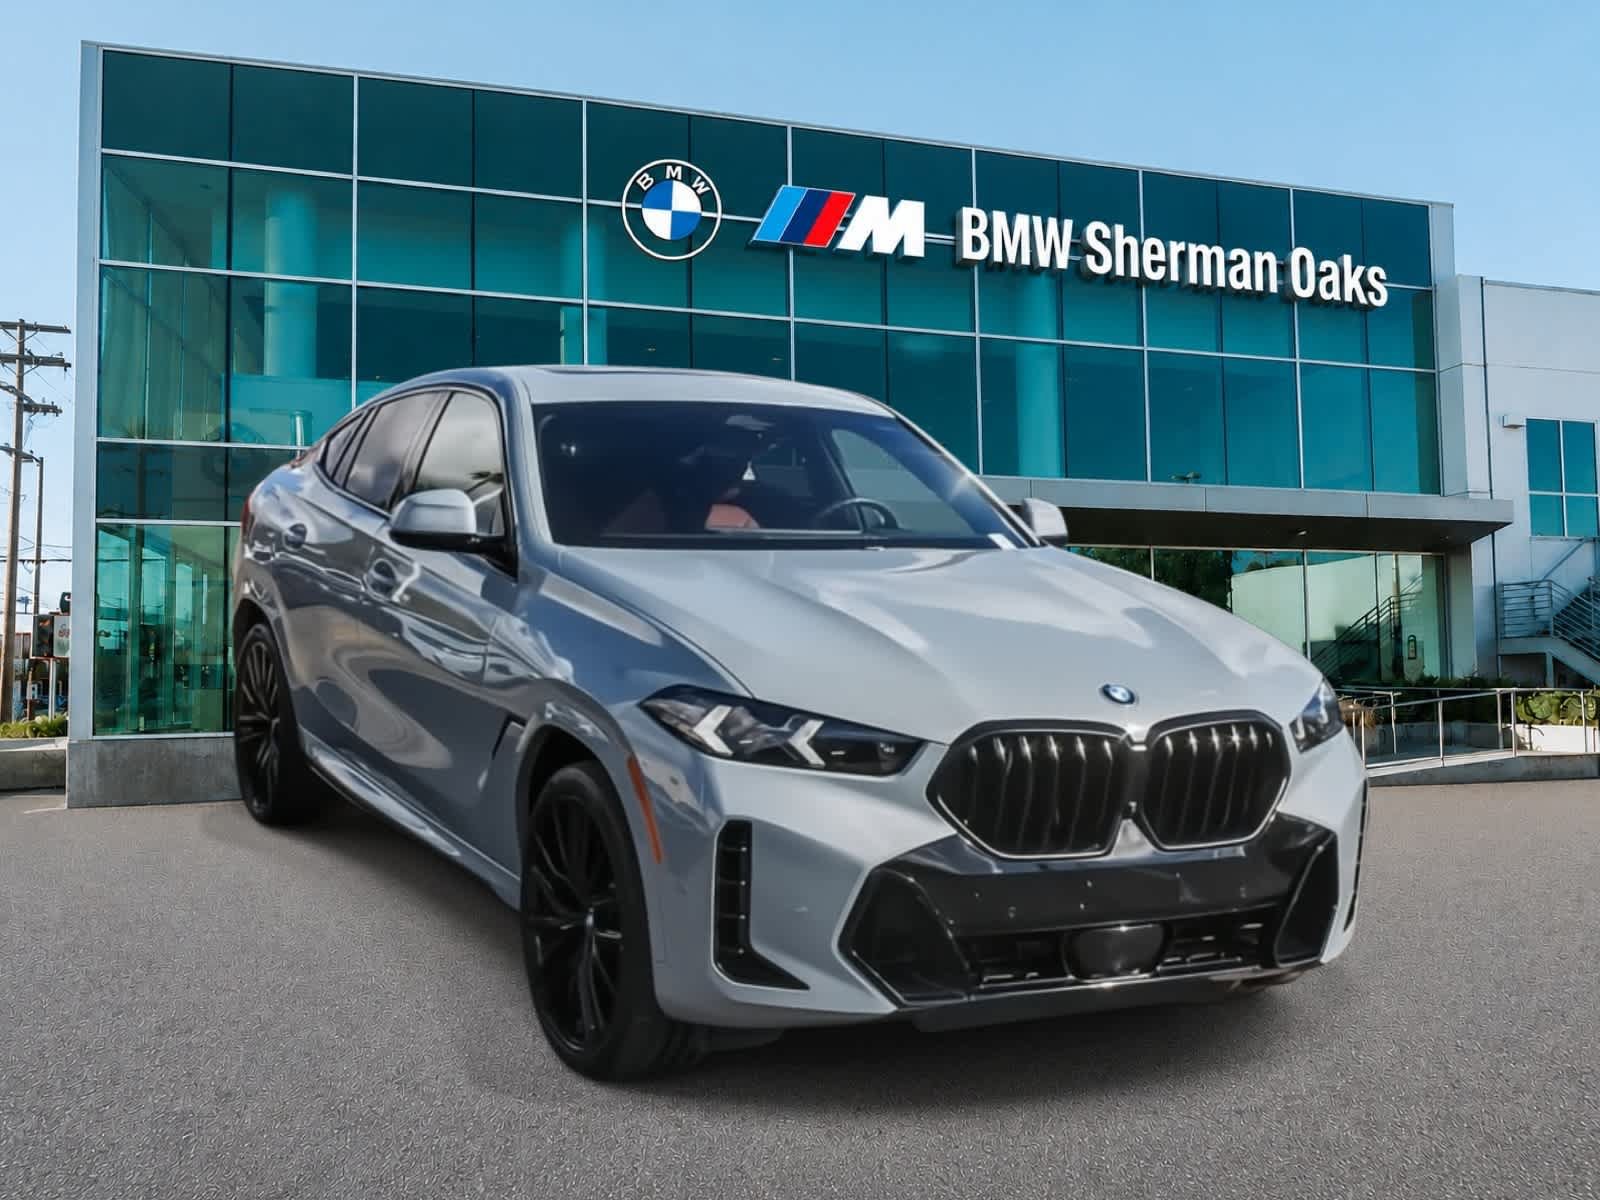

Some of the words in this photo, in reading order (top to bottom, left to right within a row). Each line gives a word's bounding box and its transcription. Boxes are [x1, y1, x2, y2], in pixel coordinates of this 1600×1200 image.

[636, 165, 712, 193] BMW
[836, 195, 925, 257] M
[961, 206, 1073, 269] BMW
[1086, 220, 1278, 294] Sherman
[1290, 246, 1388, 307] Oaks
